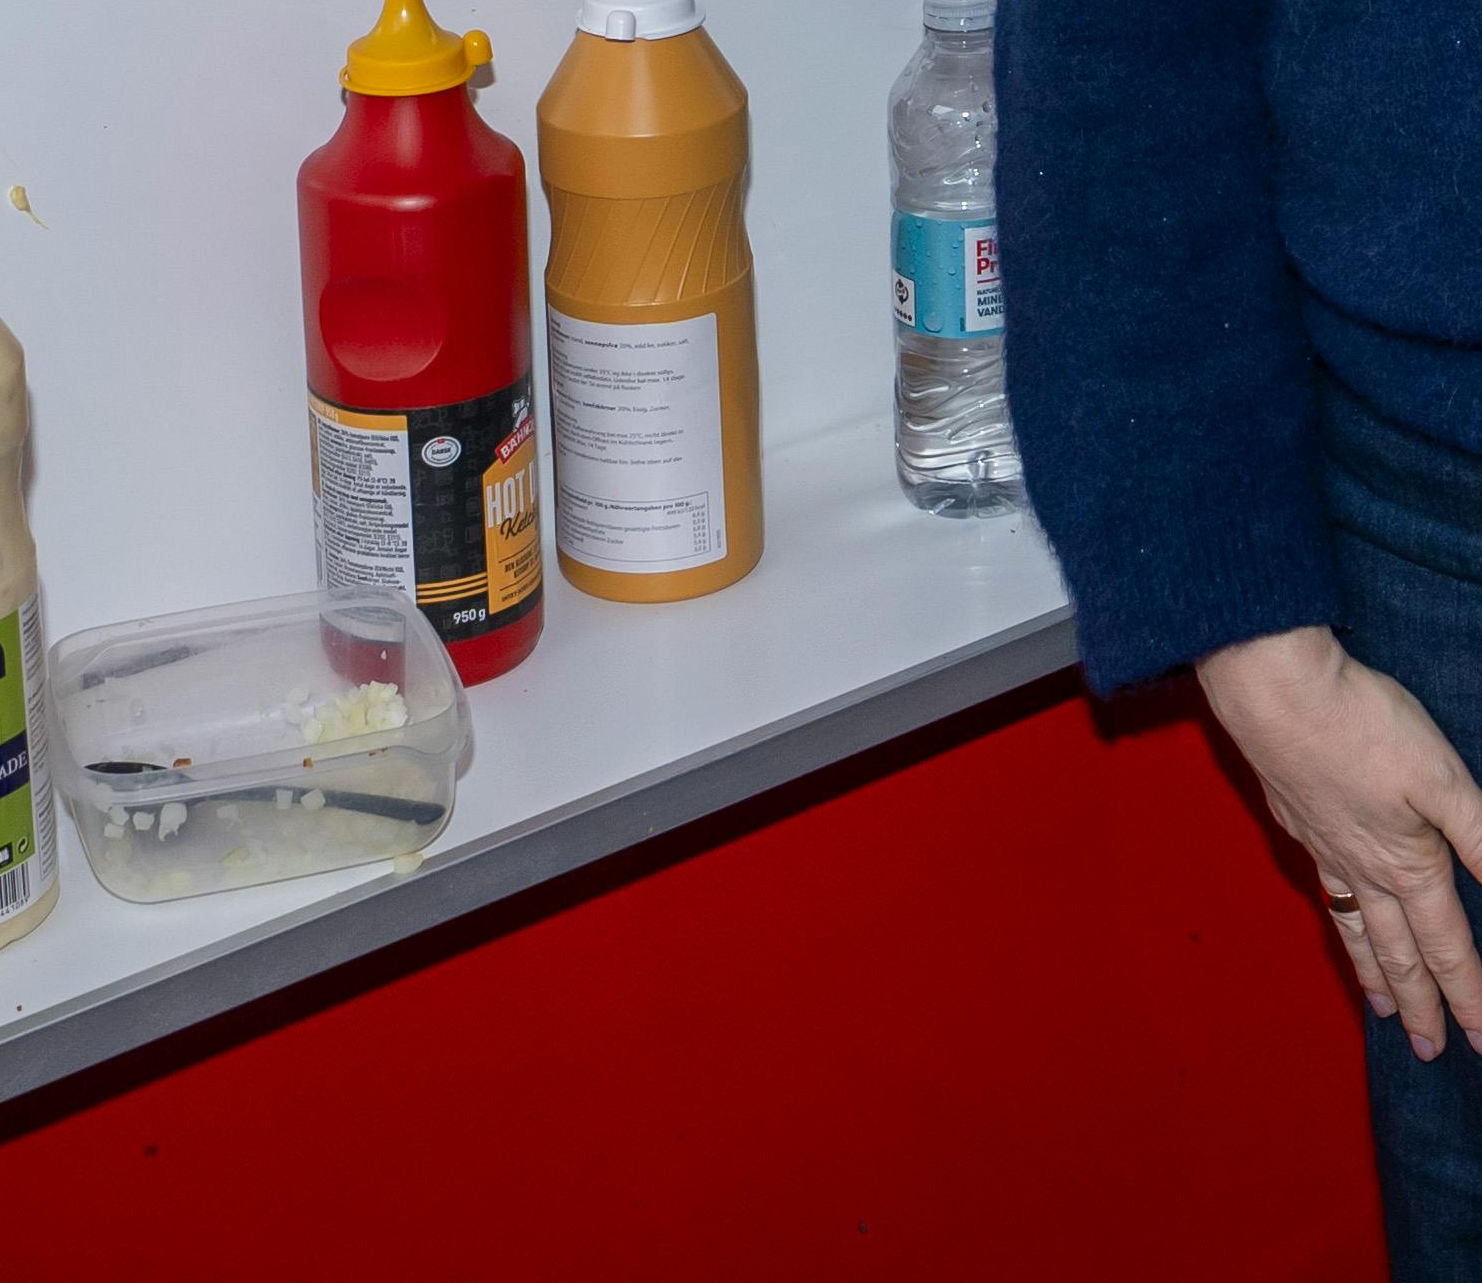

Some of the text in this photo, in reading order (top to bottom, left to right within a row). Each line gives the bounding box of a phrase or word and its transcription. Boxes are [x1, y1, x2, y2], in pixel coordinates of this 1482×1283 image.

[976, 257, 999, 276] Pr
[485, 468, 526, 529] HOT
[453, 607, 487, 625] 950 g
